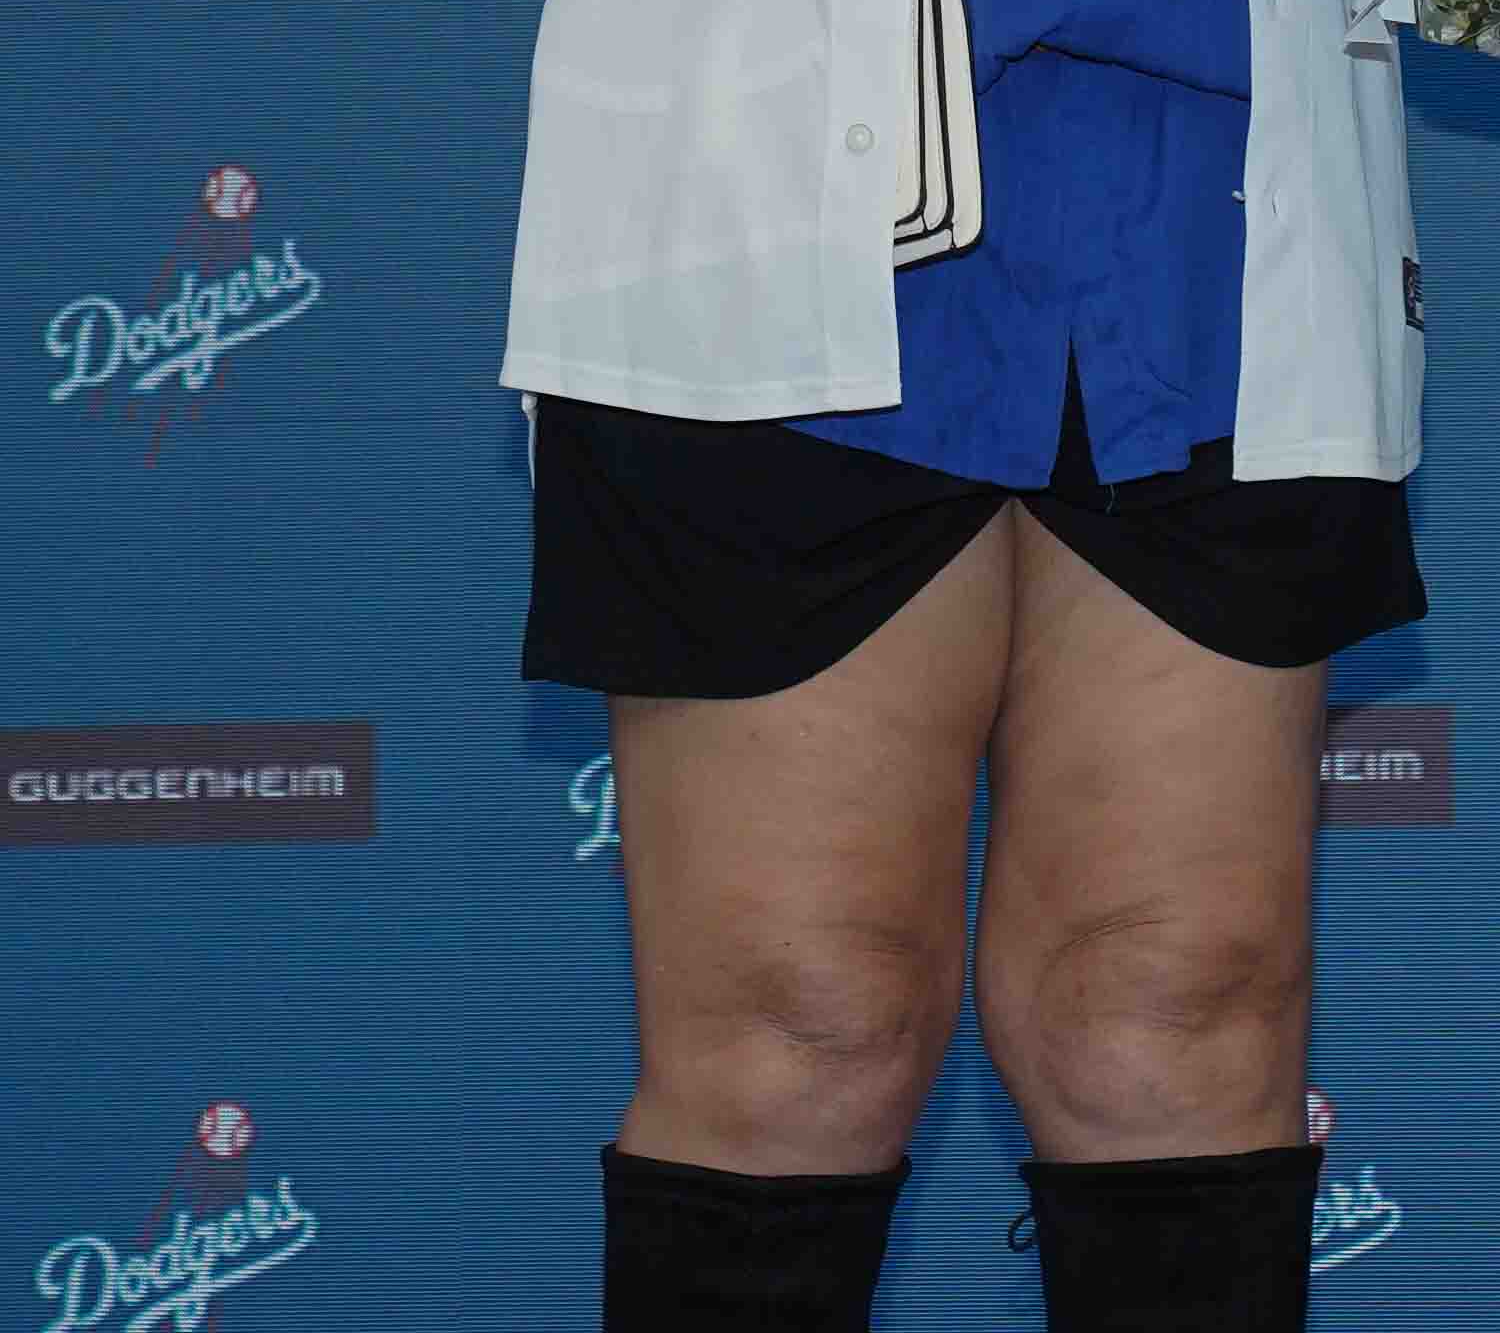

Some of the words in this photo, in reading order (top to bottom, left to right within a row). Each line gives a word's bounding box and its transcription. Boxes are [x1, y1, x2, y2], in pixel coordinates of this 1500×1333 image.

[46, 239, 321, 403] Dodgers
[7, 766, 345, 803] GUGGENHEIM
[36, 1178, 317, 1333] Dodgers
